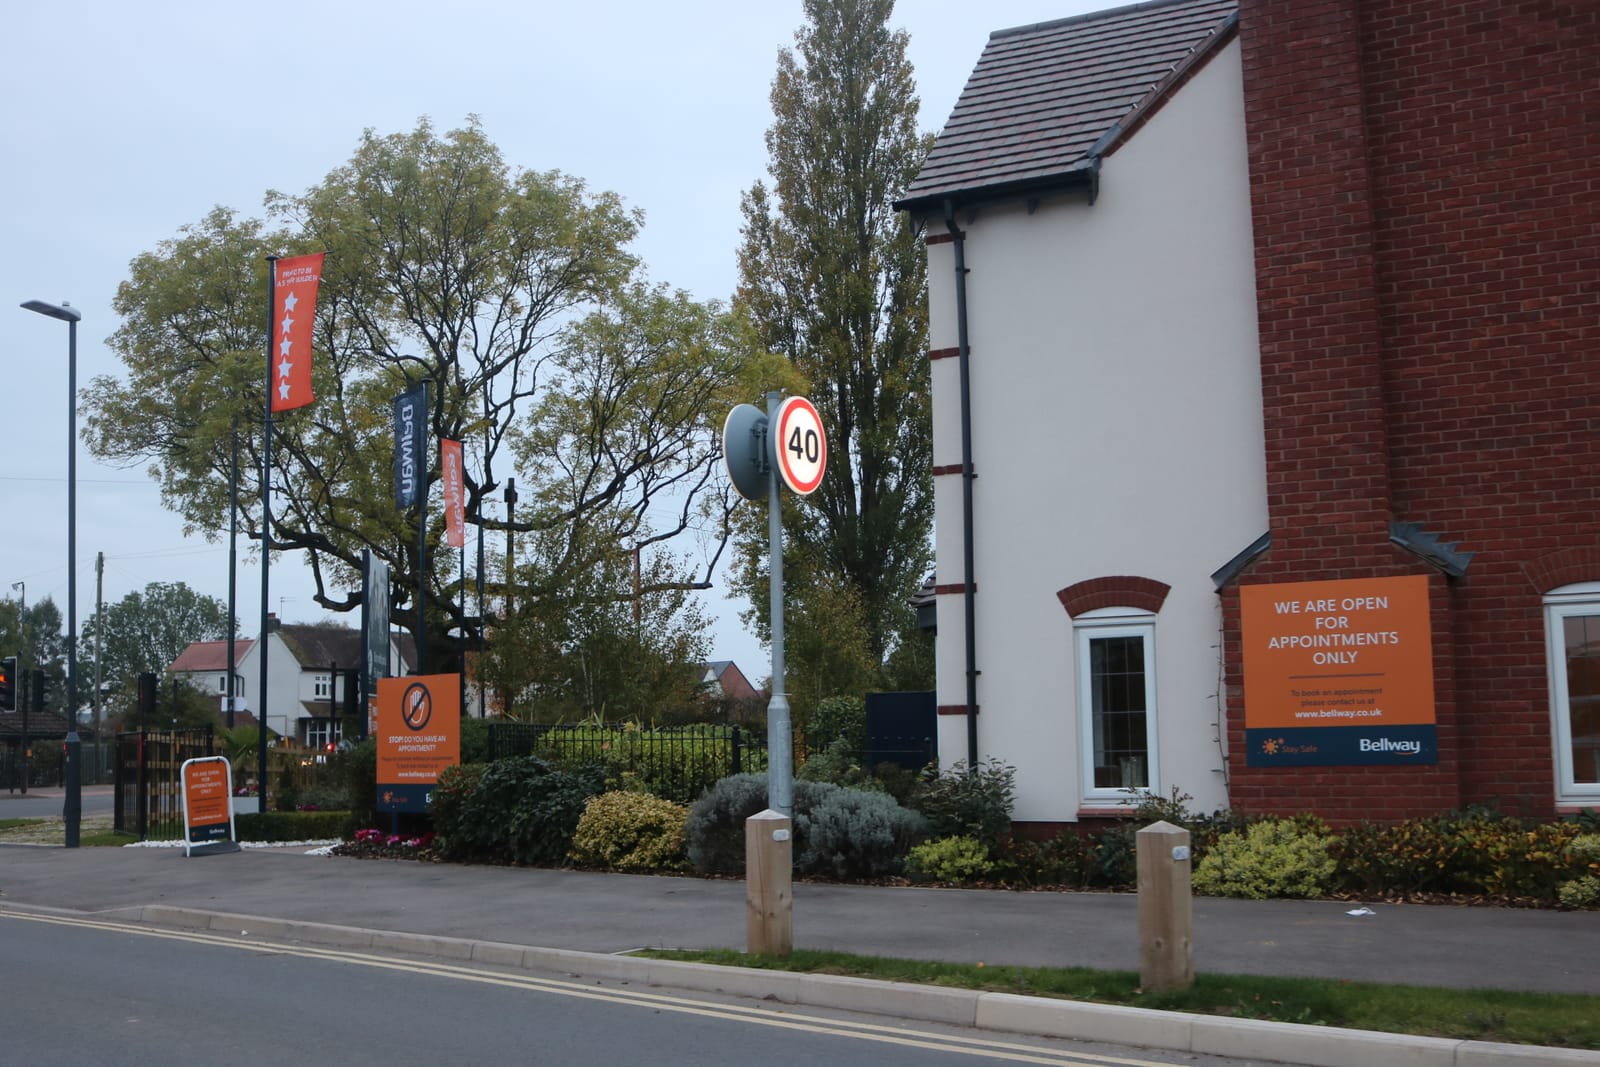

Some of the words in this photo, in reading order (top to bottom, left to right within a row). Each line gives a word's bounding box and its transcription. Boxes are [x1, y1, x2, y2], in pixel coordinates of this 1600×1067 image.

[789, 426, 819, 464] 40
[1274, 601, 1301, 614] WE
[1304, 599, 1337, 613] ARE
[1341, 596, 1389, 611] OPEN
[1315, 616, 1349, 630] FOR
[1268, 631, 1399, 649] APPOINTMENTS
[1313, 651, 1358, 665] ONLY
[1291, 689, 1301, 697] To
[1301, 687, 1321, 697] book
[1322, 688, 1333, 696] an
[1333, 687, 1383, 697] appointment
[1300, 698, 1326, 707] please
[1327, 697, 1355, 706] contact
[1367, 697, 1375, 705] at
[1295, 708, 1383, 719] www.bellway.co.uk
[388, 736, 404, 744] STOP!
[437, 735, 446, 743] AN
[397, 744, 437, 752] APPOINTMENT?
[1281, 745, 1300, 753] Stay
[1359, 738, 1421, 754] Bellway
